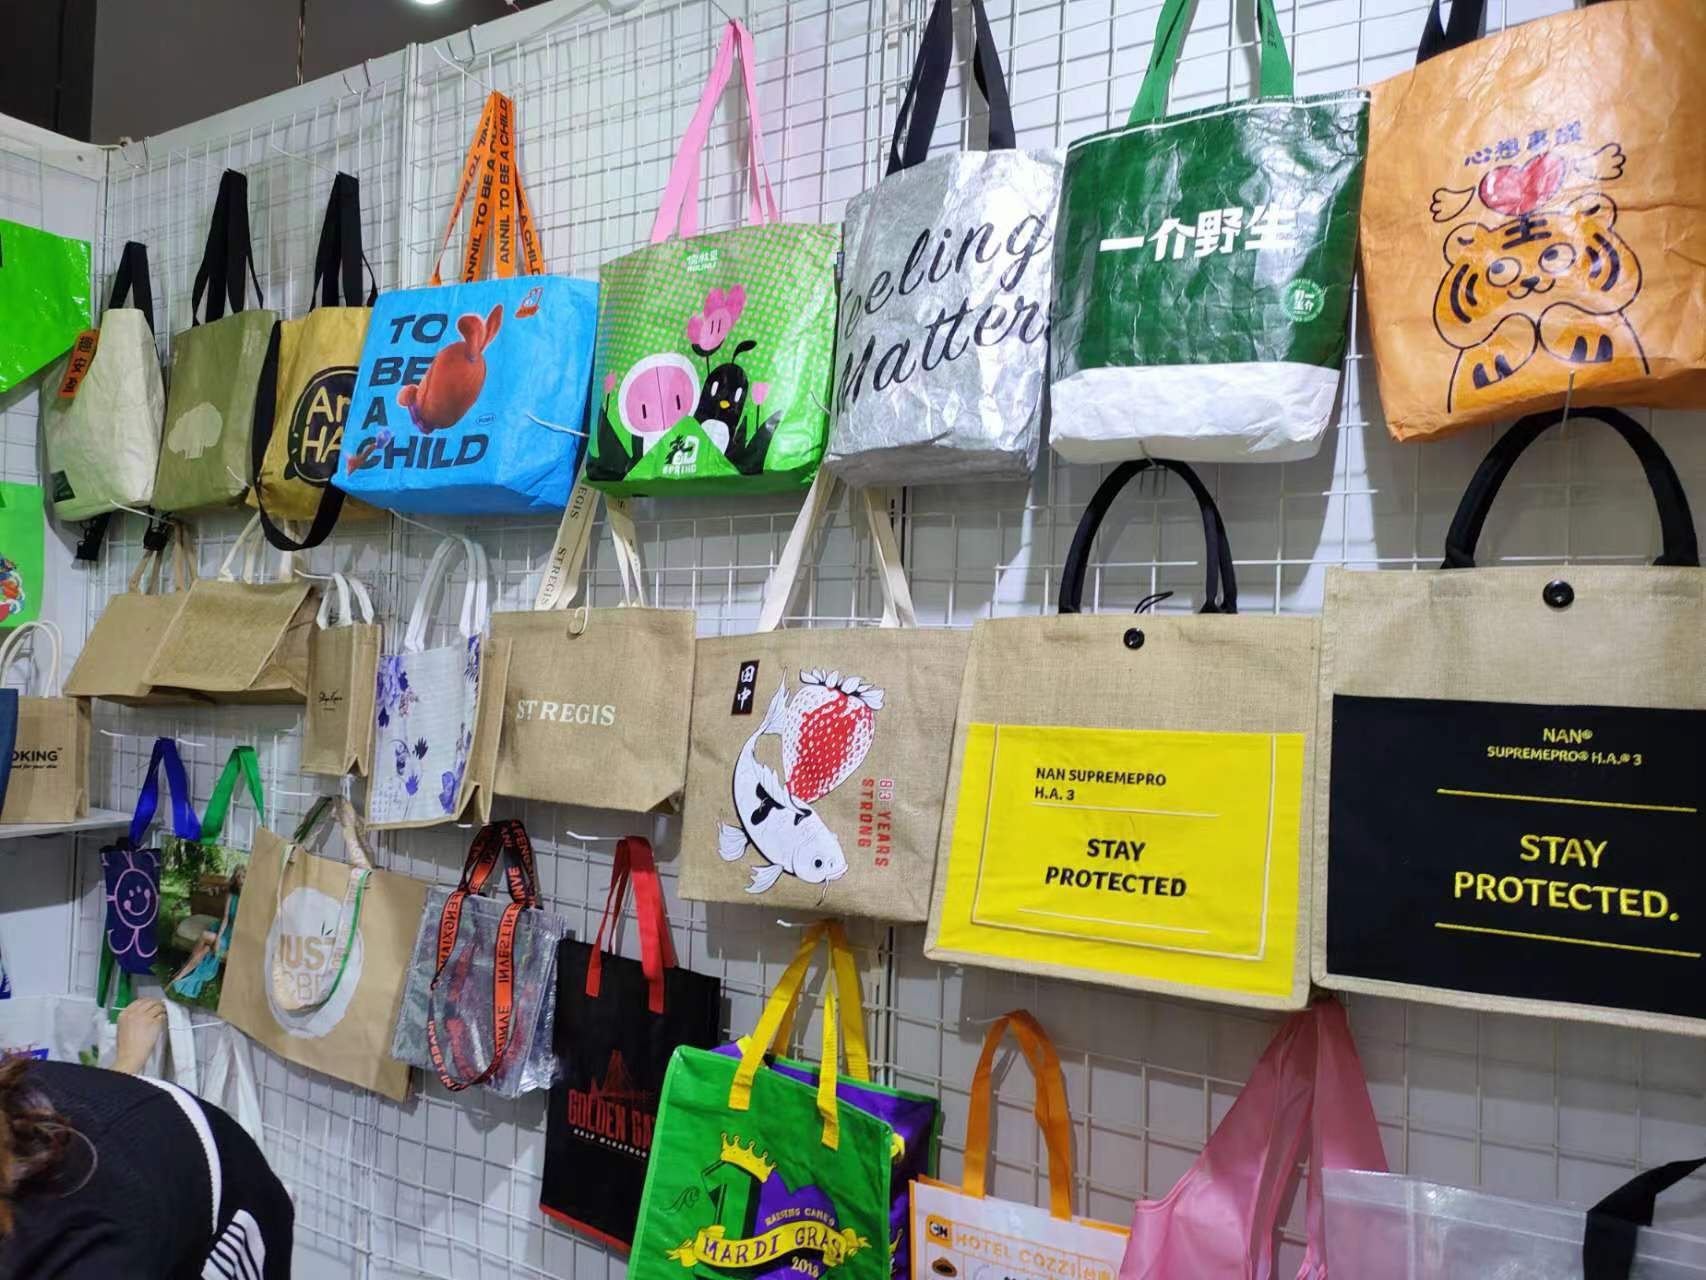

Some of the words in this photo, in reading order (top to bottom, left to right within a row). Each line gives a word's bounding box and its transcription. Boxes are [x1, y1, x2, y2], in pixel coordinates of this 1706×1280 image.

[500, 151, 509, 161] A
[481, 174, 494, 199] BE
[500, 163, 510, 187] BE
[500, 189, 510, 210] TO
[476, 203, 488, 228] TO
[500, 214, 509, 264] ANNIL
[1099, 203, 1297, 261] 一介野生
[390, 313, 448, 345] TO
[369, 356, 438, 387] BE
[361, 397, 388, 430] A
[355, 434, 490, 470] CHILD
[570, 487, 588, 520] EGIS
[539, 701, 617, 726] REGIS
[1632, 754, 1642, 766] 3
[1036, 767, 1066, 781] NAN
[1068, 770, 1167, 786] SUPREMEPRO
[1034, 786, 1063, 800] H.A.
[1066, 789, 1075, 801] 3
[857, 777, 875, 849] STRONG
[875, 810, 892, 868] YEARS
[1087, 838, 1147, 862] STAY
[1520, 834, 1608, 868] STAY
[1045, 866, 1187, 898] PROTECTED
[1454, 871, 1680, 922] PROTECTED.
[632, 1110, 656, 1149] GA
[703, 1233, 781, 1264] MARDI
[795, 1226, 842, 1260] GRAS
[954, 1233, 1012, 1261] HOTEL
[791, 1256, 820, 1278] 2018
